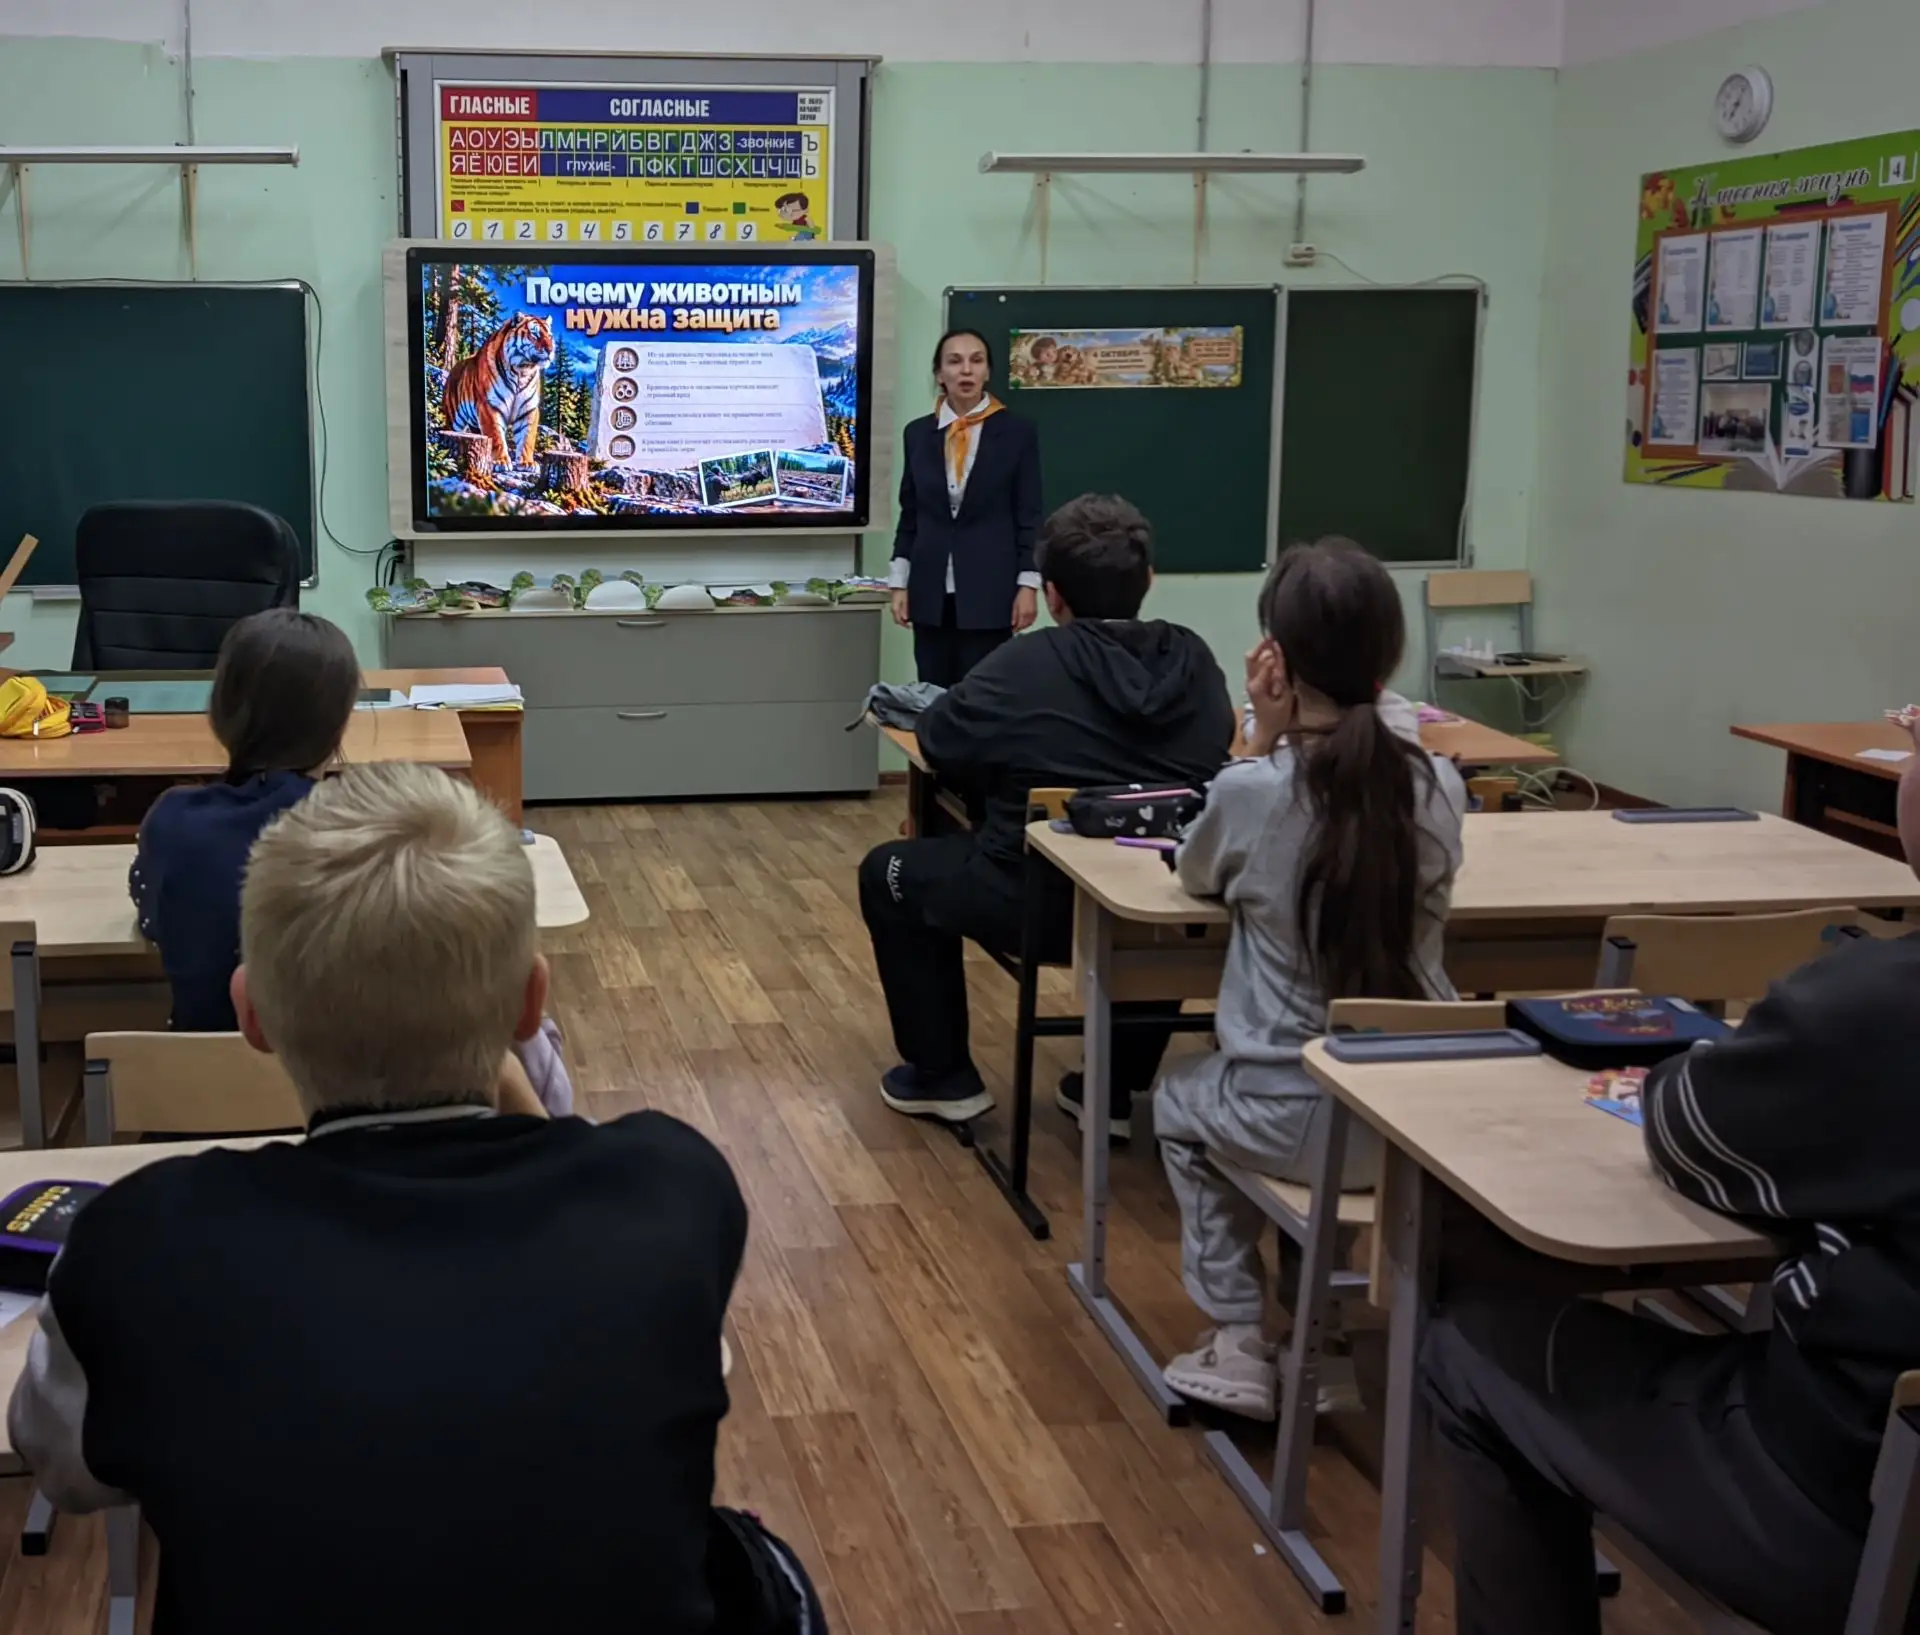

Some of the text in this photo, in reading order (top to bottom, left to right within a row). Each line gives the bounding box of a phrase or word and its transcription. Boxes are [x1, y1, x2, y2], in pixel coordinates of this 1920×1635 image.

[450, 96, 530, 115] ГЛАСНЫЕ
[610, 98, 710, 117] СОГЛАСНЫЕ
[737, 137, 795, 149] -ЗВОНКИЕ
[567, 161, 616, 172] ГЛУХИЕ-
[1794, 168, 1871, 206] жизнь
[454, 223, 752, 239] 0 1 2 3 4 5 6 7 8 9
[526, 276, 802, 309] Почему животным
[566, 308, 780, 336] нужна защита
